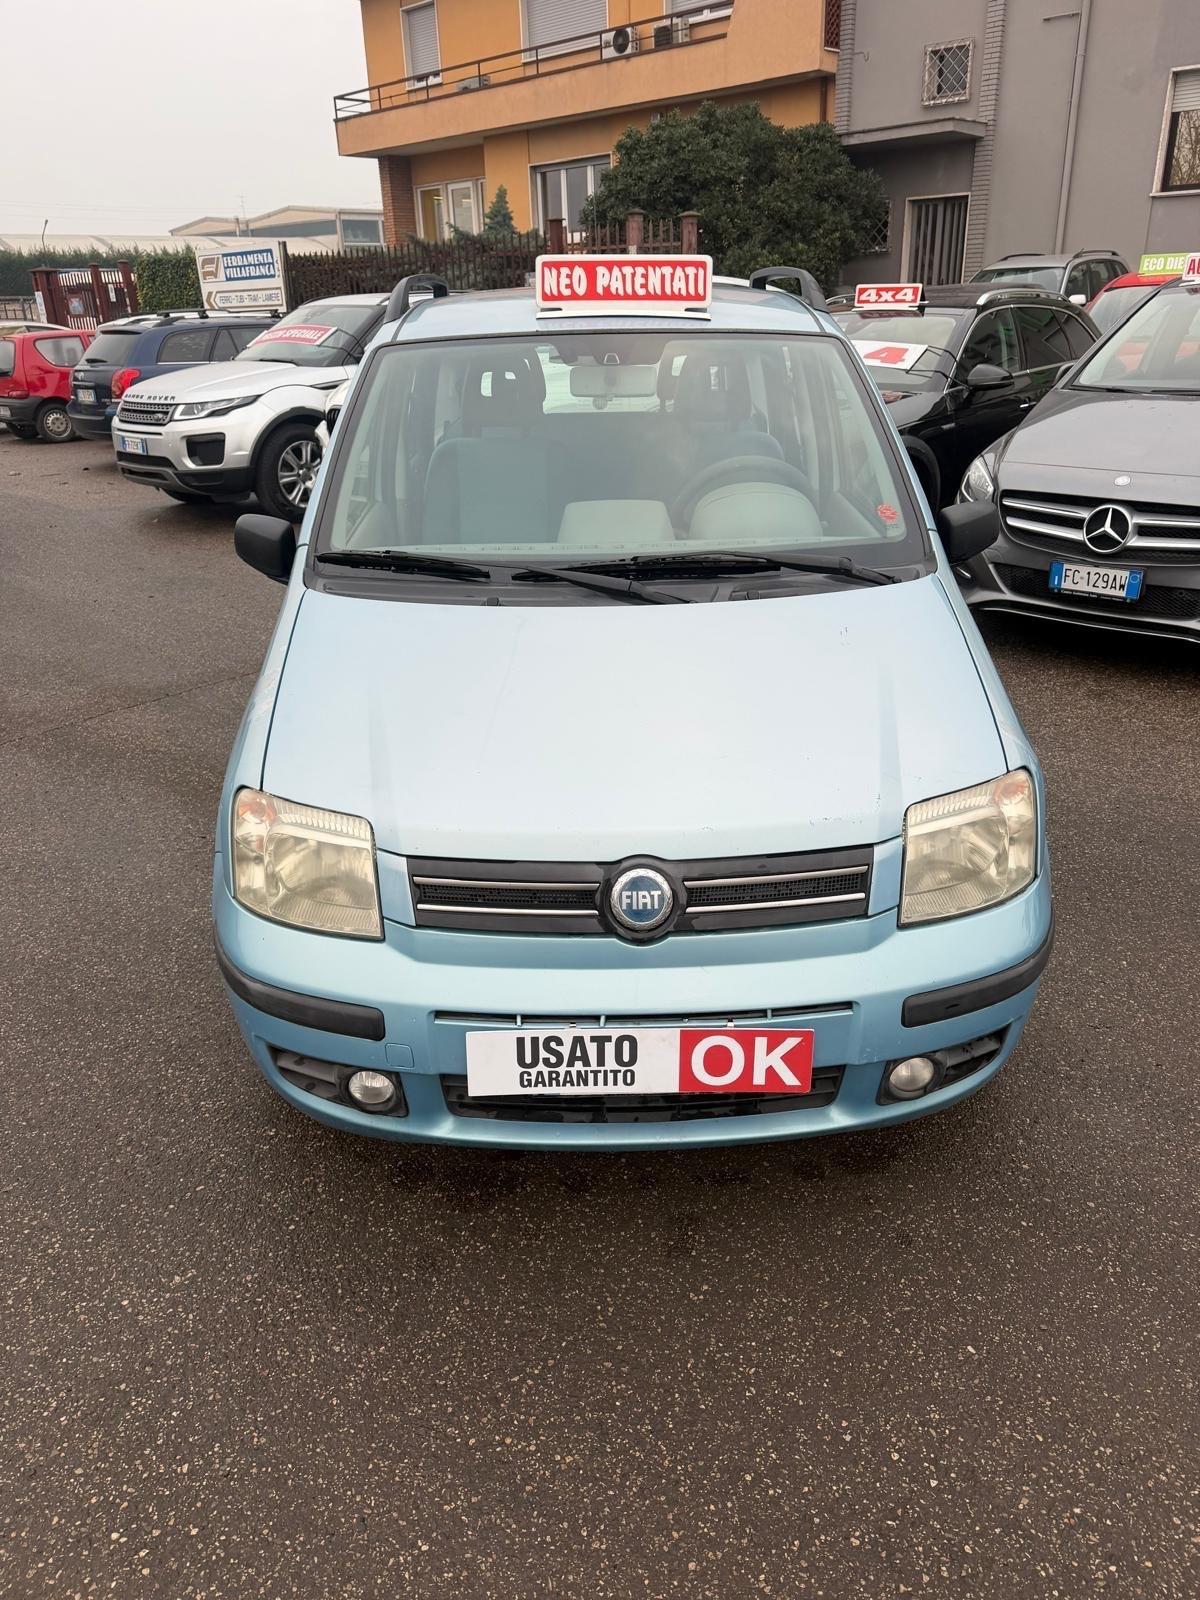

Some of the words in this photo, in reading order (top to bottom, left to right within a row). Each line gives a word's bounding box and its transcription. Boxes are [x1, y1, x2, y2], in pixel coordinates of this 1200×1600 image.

[223, 252, 273, 267] FERRAMENTA
[1143, 257, 1165, 271] ECO
[225, 264, 275, 278] VILLAFRANCA
[543, 265, 588, 296] NEO
[596, 264, 705, 297] PATENTATI
[860, 287, 915, 302] 4x4
[283, 329, 325, 340] SPECIALE
[621, 890, 662, 910] FIAT
[516, 1034, 639, 1069] USATO
[690, 1034, 803, 1087] OK
[519, 1068, 636, 1089] GARANTITO
